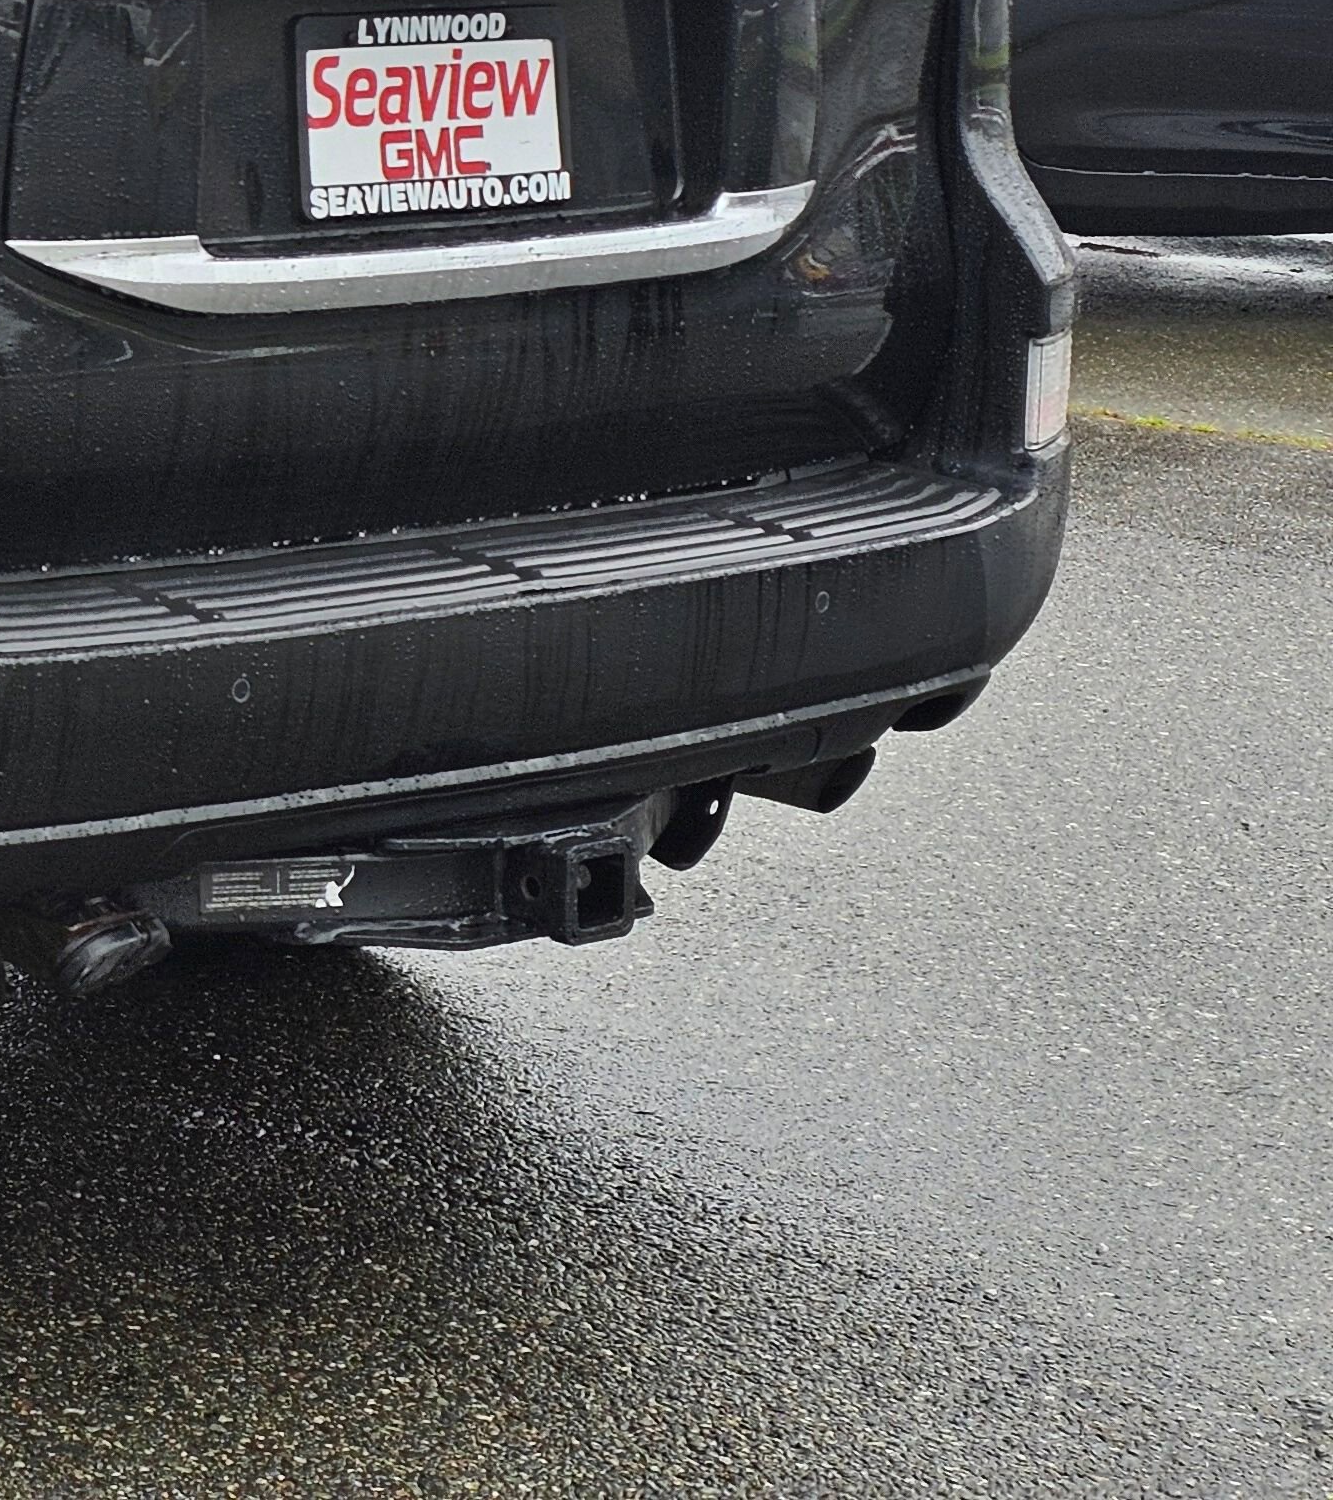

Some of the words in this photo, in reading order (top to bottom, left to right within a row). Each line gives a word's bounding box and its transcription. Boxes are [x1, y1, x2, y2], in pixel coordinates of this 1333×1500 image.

[357, 12, 506, 45] LYNNWOOD
[307, 48, 551, 130] Seaview
[379, 125, 491, 181] GMC
[309, 171, 572, 219] SEAVIEWAUTO.COM
